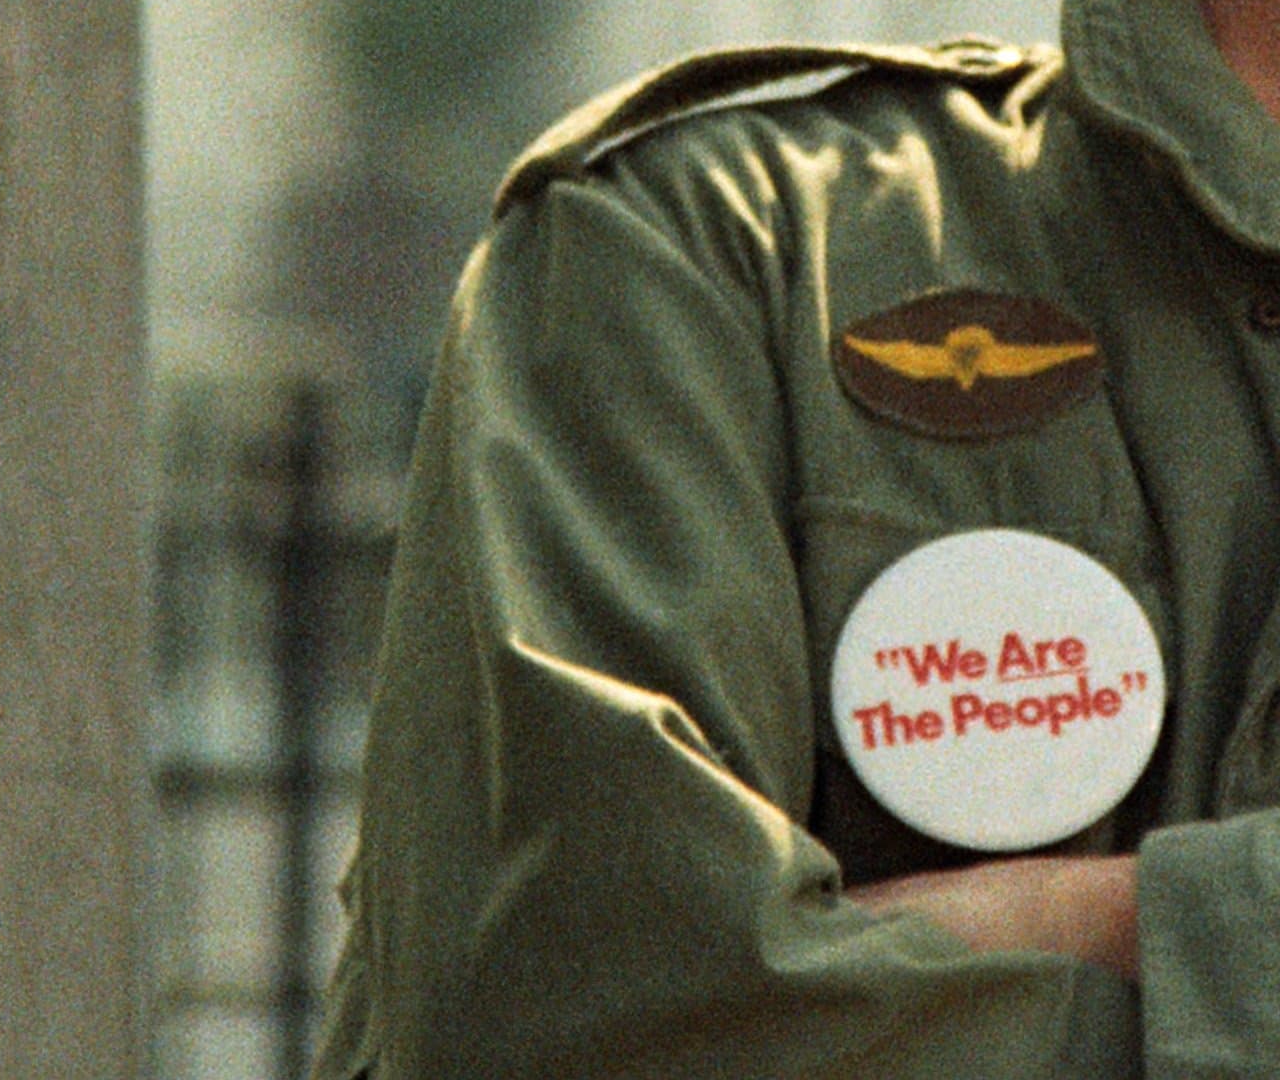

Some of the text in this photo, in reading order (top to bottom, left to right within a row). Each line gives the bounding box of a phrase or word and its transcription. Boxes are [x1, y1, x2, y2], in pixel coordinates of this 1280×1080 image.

[873, 631, 1087, 688] "We Are
[852, 670, 1148, 751] The People"
